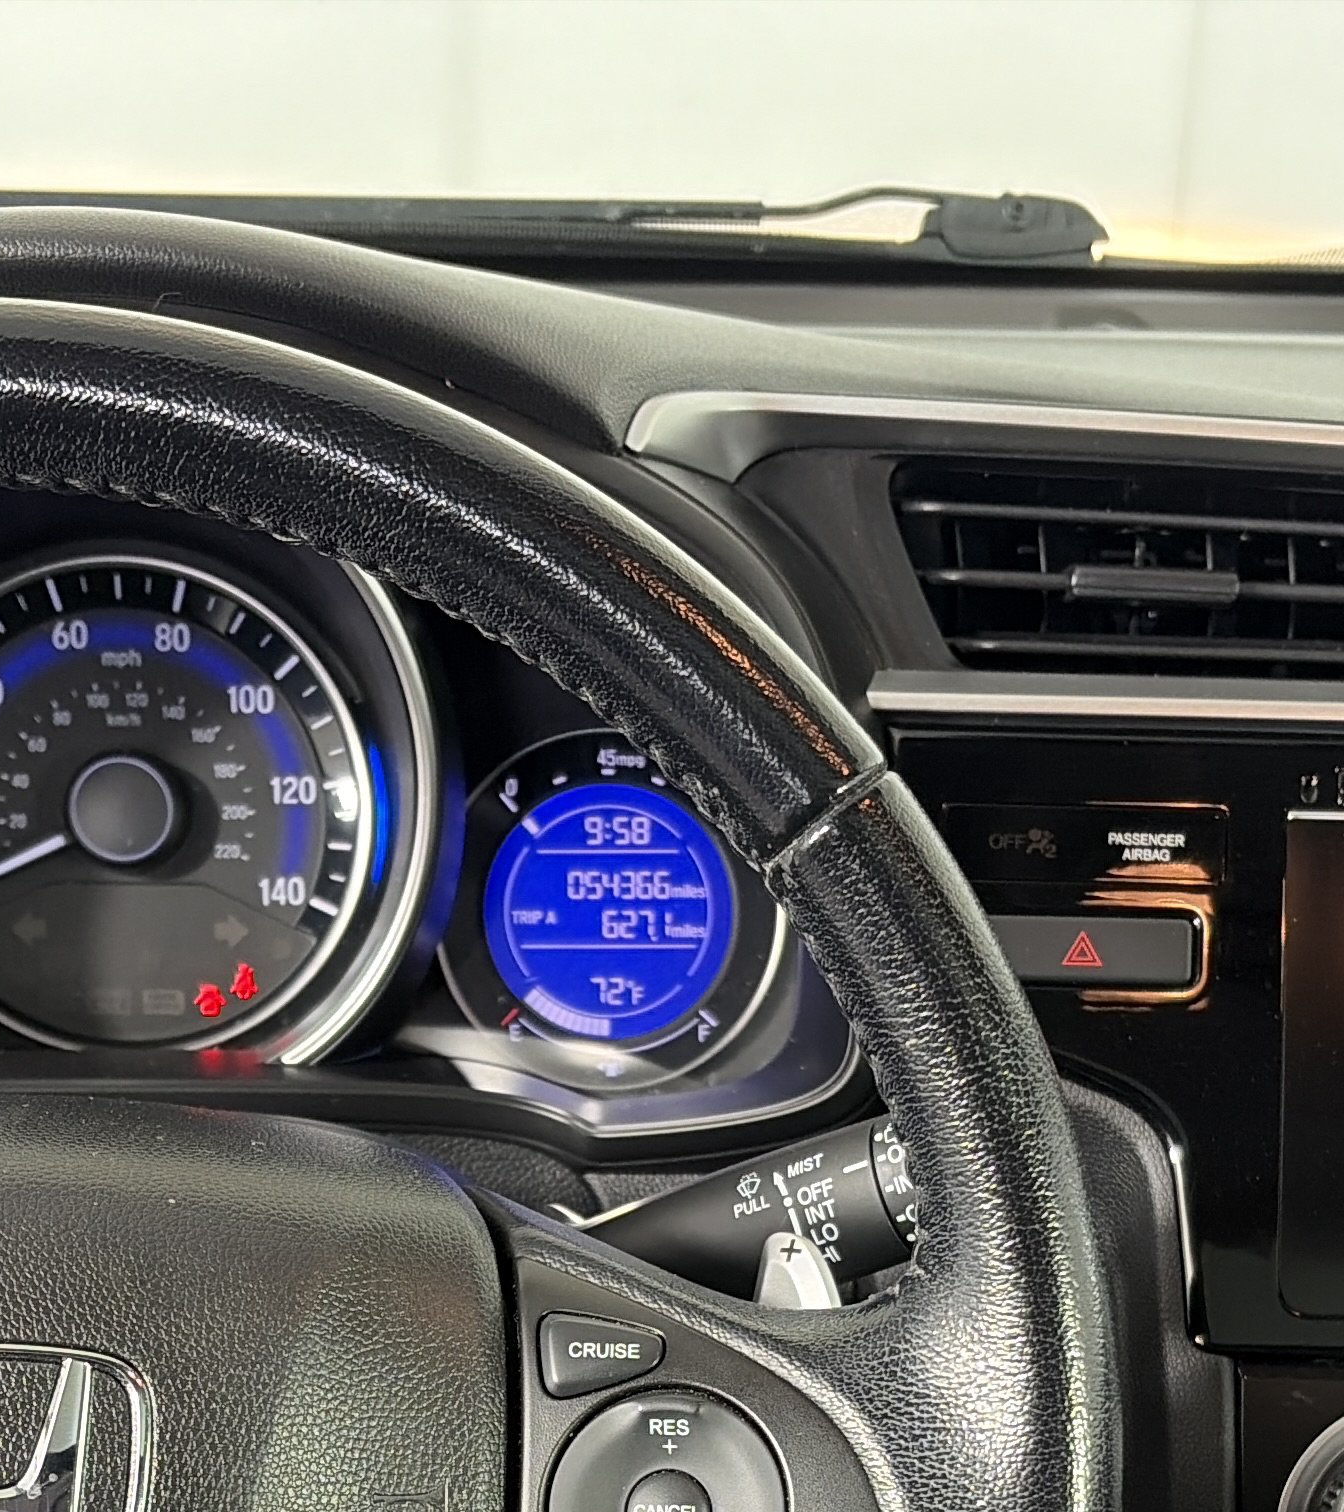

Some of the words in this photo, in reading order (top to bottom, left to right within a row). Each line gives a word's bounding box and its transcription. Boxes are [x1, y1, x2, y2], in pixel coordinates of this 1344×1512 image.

[52, 620, 88, 650] 60
[156, 623, 190, 652] 80
[101, 650, 142, 671] mph
[228, 686, 274, 714] 100
[270, 777, 316, 805] 120
[505, 778, 519, 796] 0
[584, 816, 651, 845] 9:58
[1107, 831, 1186, 847] PASSENGER
[1121, 848, 1171, 861] AIRBAG
[259, 877, 305, 906] 140
[567, 871, 670, 900] 054366
[511, 910, 543, 925] TRIP
[544, 910, 558, 925] A
[508, 1024, 522, 1042] E
[697, 1024, 712, 1043] F
[787, 1153, 824, 1178] MIST
[797, 1177, 833, 1206] OFF
[733, 1195, 771, 1219] PULL
[804, 1198, 835, 1225] INT
[810, 1222, 839, 1246] LO
[568, 1341, 641, 1360] CRUISE
[648, 1418, 690, 1437] RES
